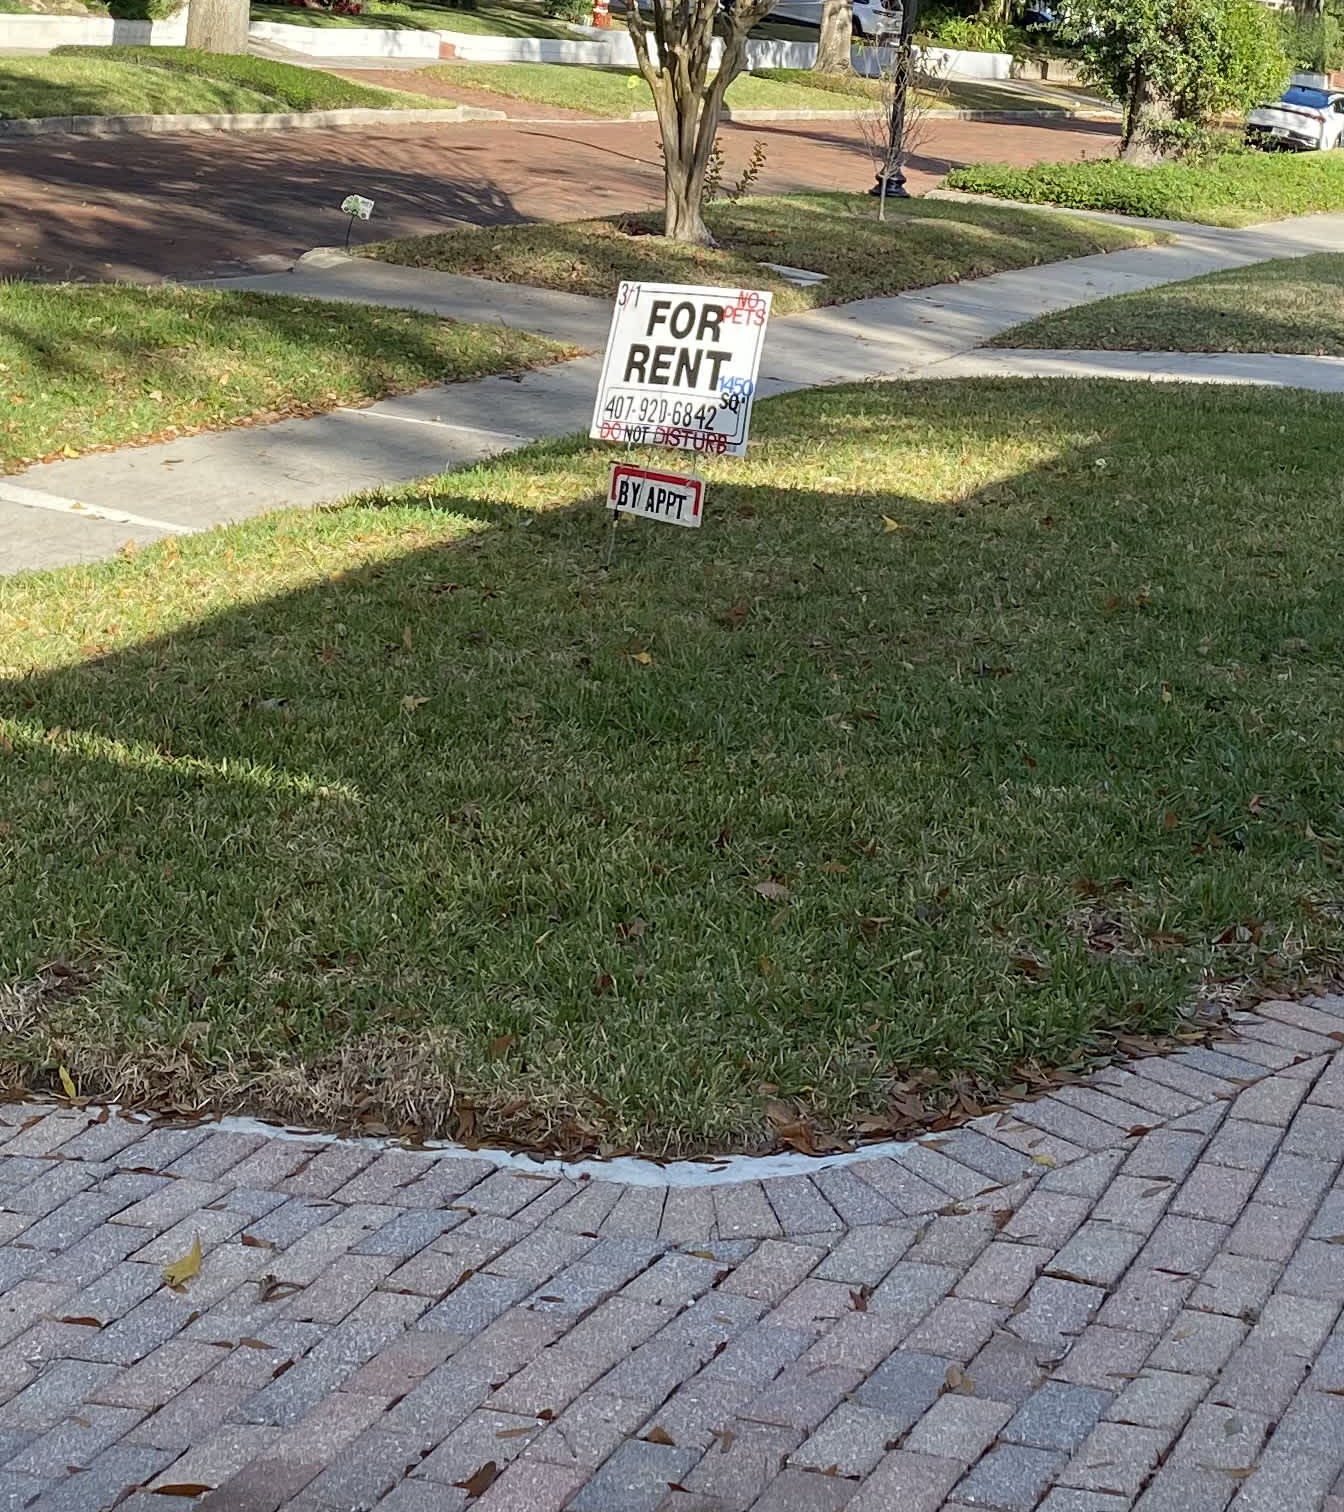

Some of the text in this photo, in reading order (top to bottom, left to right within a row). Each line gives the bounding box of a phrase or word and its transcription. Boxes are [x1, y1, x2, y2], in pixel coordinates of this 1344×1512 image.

[722, 306, 766, 327] PETS
[737, 291, 759, 309] NO
[646, 299, 723, 342] FOR
[623, 343, 732, 391] RENT
[719, 376, 754, 397] 1450
[605, 394, 718, 431] 407-920-6842
[600, 422, 728, 455] DO NOT DISTURB
[617, 480, 688, 520] BY APPT
